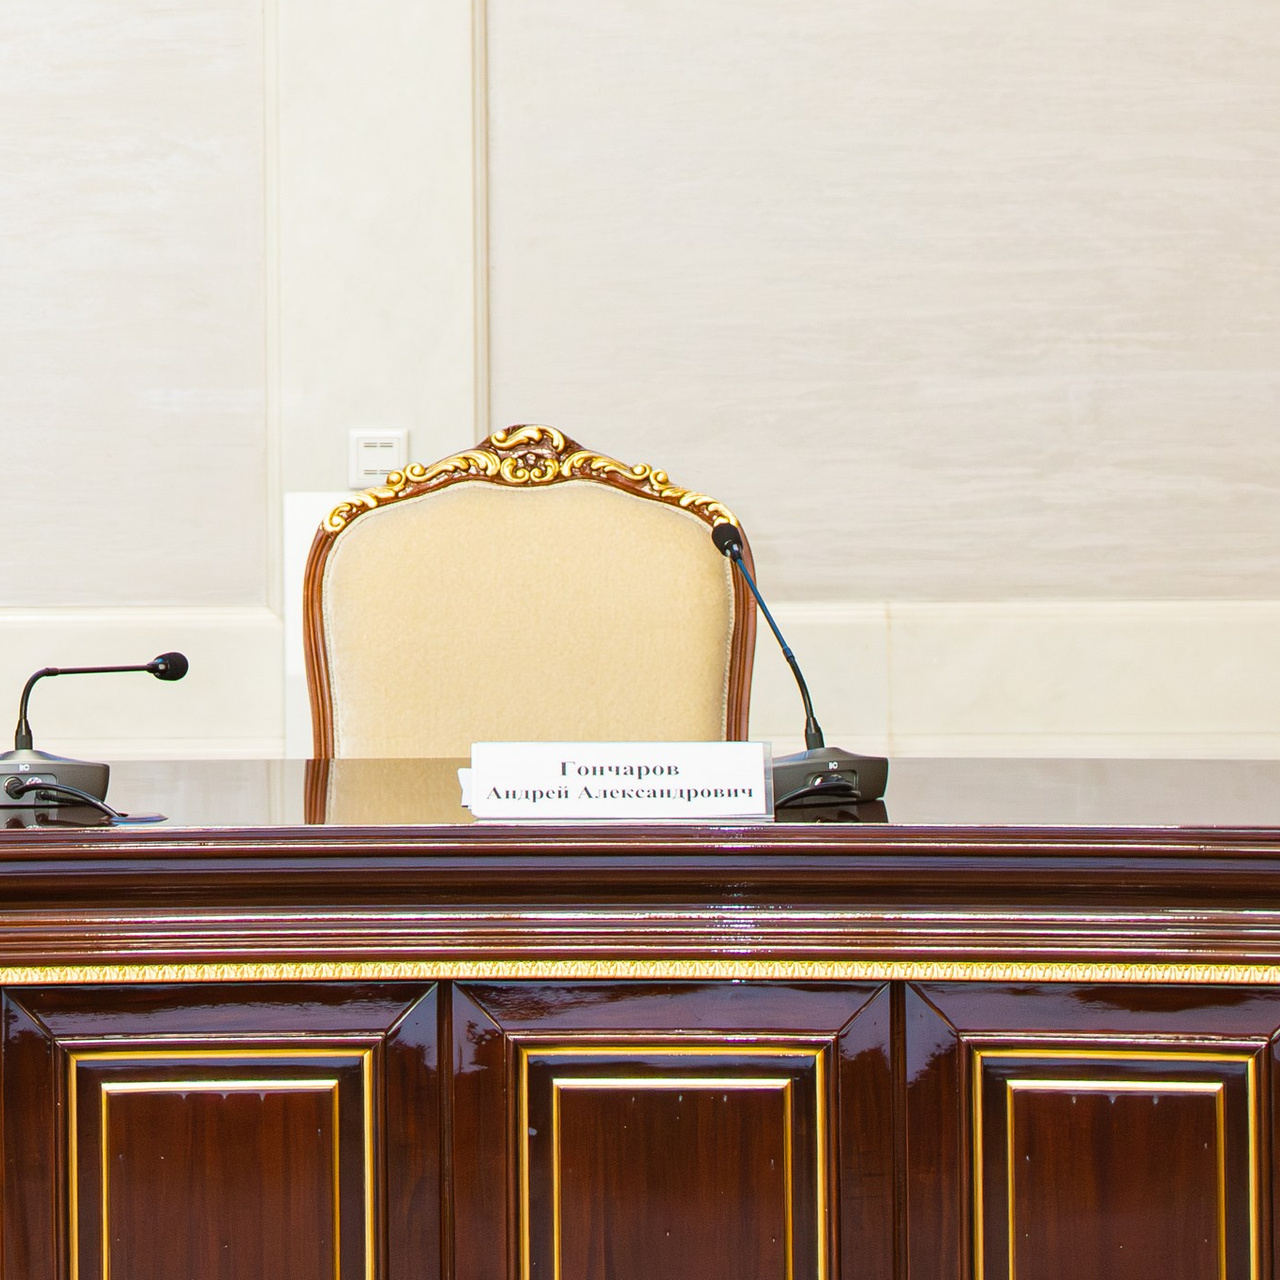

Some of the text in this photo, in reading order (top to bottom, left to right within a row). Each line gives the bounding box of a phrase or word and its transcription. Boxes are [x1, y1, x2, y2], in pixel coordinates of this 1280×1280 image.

[560, 761, 680, 781] Гончаров
[486, 785, 754, 804] Андрей Александрович
